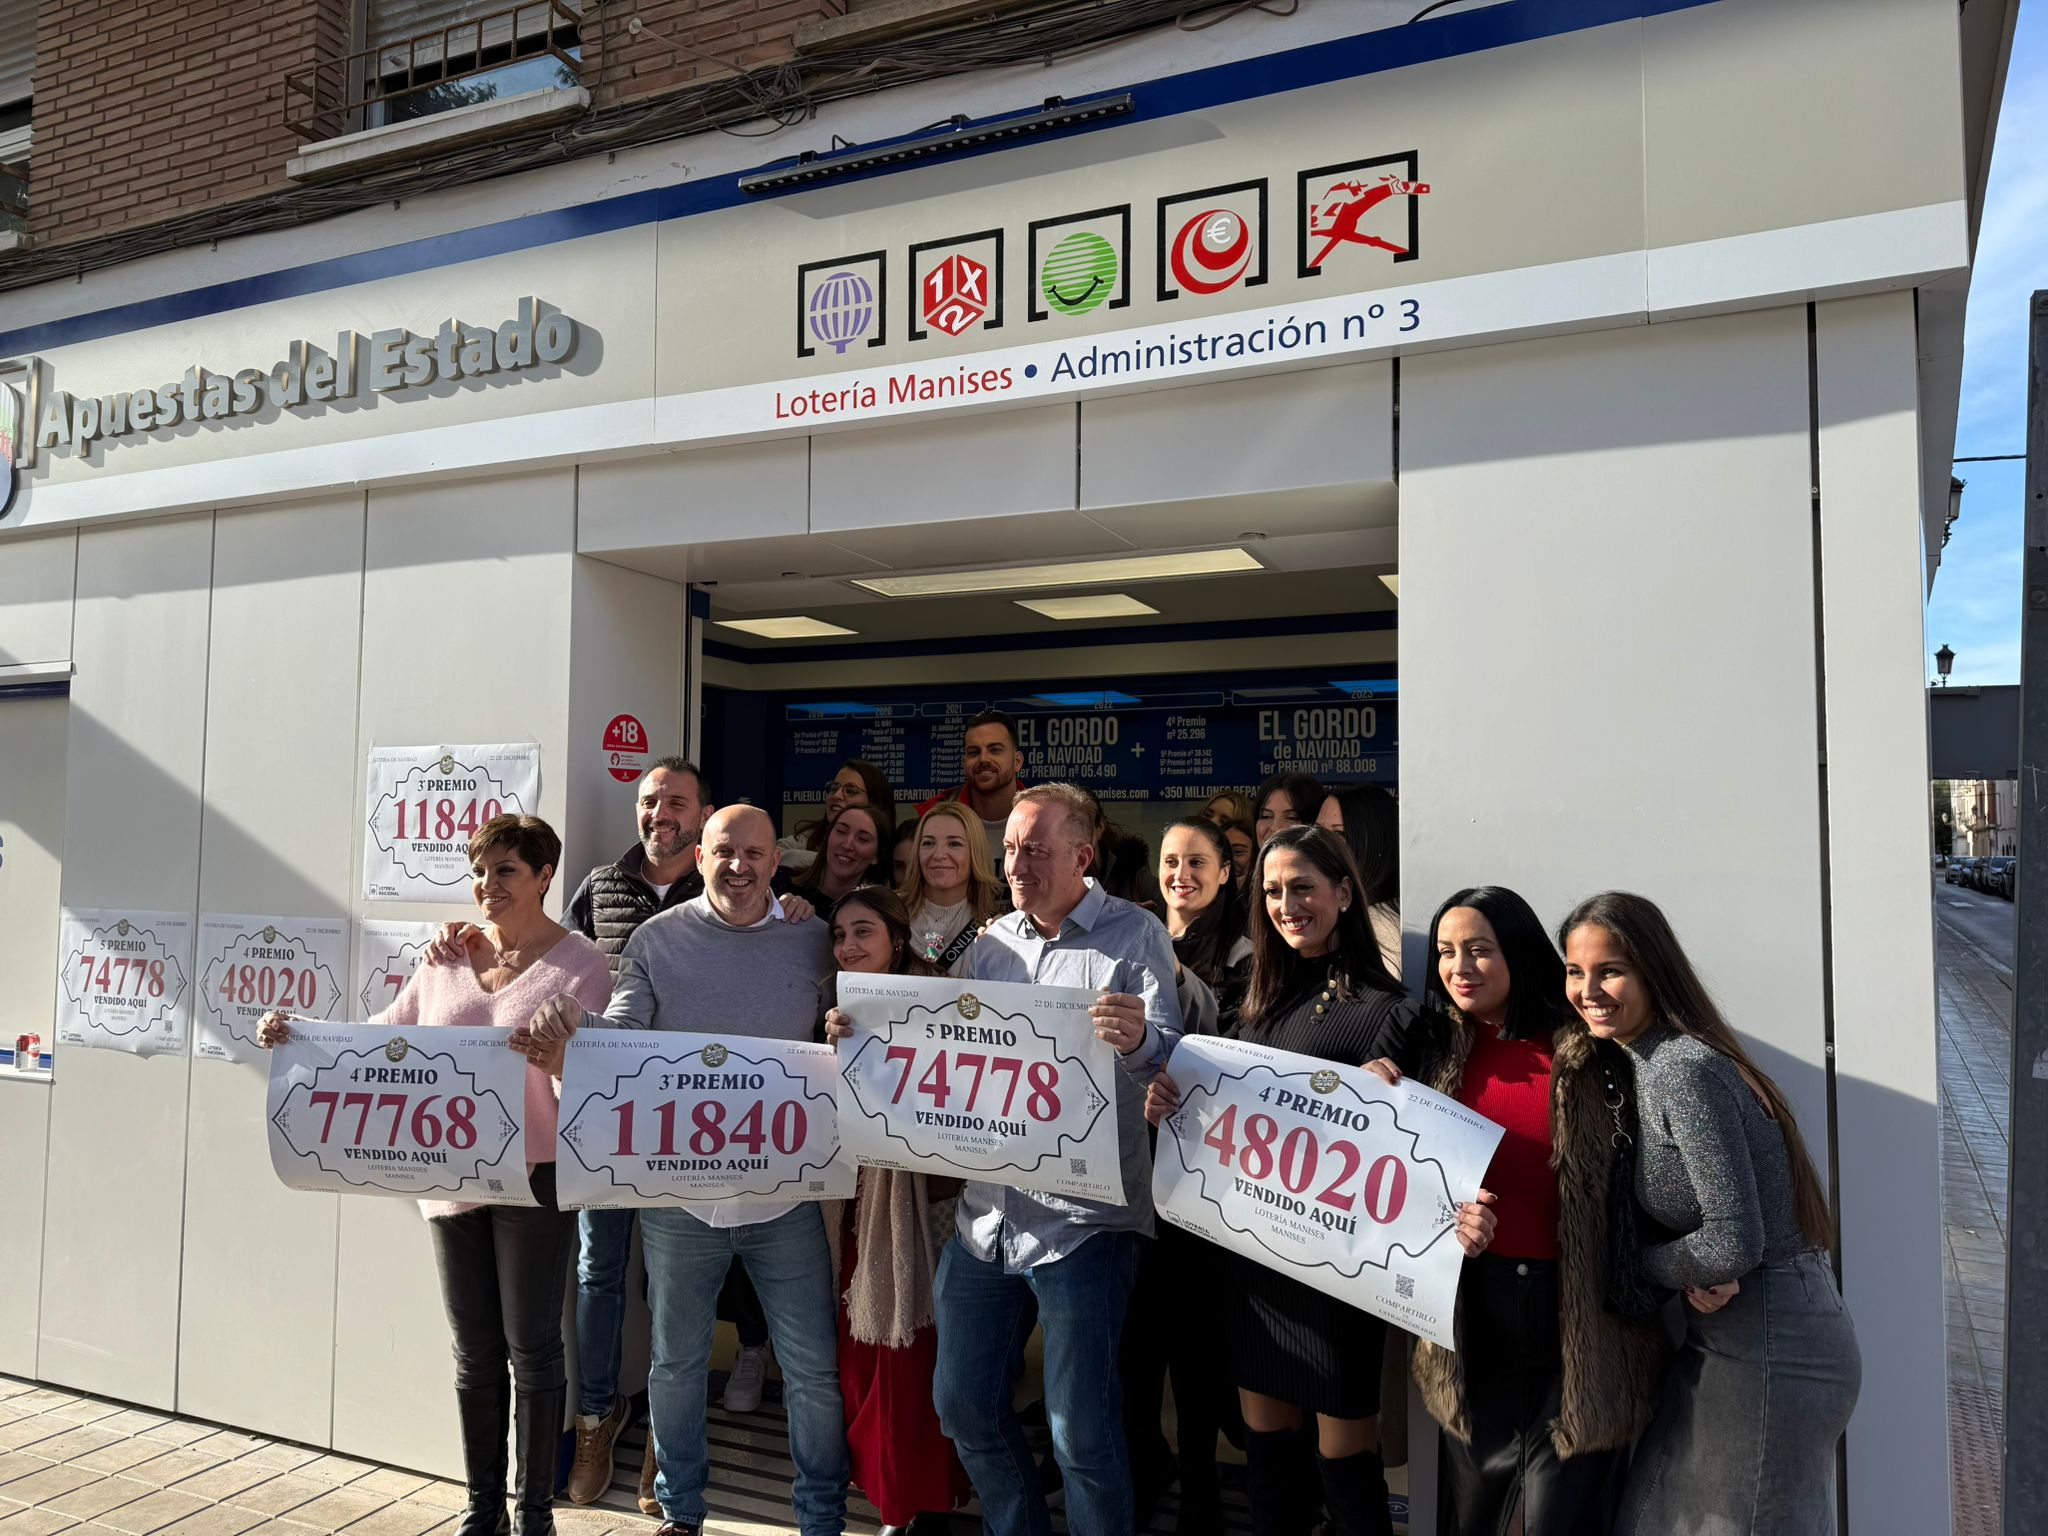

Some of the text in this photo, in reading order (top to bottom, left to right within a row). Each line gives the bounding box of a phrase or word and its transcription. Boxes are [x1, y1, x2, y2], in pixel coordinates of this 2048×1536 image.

[775, 298, 1421, 419] Lotería Manises Administración nº 3
[37, 295, 578, 459] Apuestas del Estado
[945, 704, 963, 714] 2021
[1177, 715, 1206, 727] Premio
[1258, 706, 1377, 741] EL GORDO
[612, 720, 639, 744] +18
[1017, 716, 1119, 748] EL GORDO
[1177, 728, 1206, 740] 25.296
[1028, 745, 1103, 766] de NAVIDAD
[1273, 738, 1361, 761] de NAVIDAD
[1031, 764, 1067, 780] PREMIO
[1081, 763, 1117, 779] 05.490
[1259, 761, 1276, 775] 1er
[1278, 758, 1319, 774] PREMIO
[1336, 759, 1377, 774] 88.008
[428, 778, 477, 792] PREMIO
[1159, 785, 1182, 799] +350
[783, 792, 791, 803] EL
[792, 791, 821, 803] PUEBLO
[893, 788, 937, 801] REPARTIDO
[411, 842, 470, 854] VENDIDO AQ
[108, 940, 146, 953] PREMIO
[252, 946, 295, 961] PREMIO
[80, 955, 165, 998] 74778
[219, 963, 316, 1009] 48020
[875, 989, 884, 997] DE
[885, 988, 919, 999] NAVIDAD
[94, 995, 147, 1008] VENDIDO AQUÍ
[1034, 1000, 1091, 1011] 22 DE DICIEMB
[288, 1033, 311, 1042] OTERÍA
[322, 1035, 354, 1044] NAVIDAD
[939, 1023, 1017, 1047] PREMIO
[571, 1039, 660, 1050] LOTERÍA DE NAVIDAD
[787, 1047, 795, 1055] 22
[1237, 1046, 1274, 1062] NAVIDAD
[364, 1067, 439, 1085] PREMIO
[676, 1073, 765, 1091] PREMIO
[884, 1045, 1061, 1122] 74778
[1275, 1089, 1371, 1133] PREMIO
[1407, 1093, 1486, 1133] 22 DE DICIEMBRE
[309, 1090, 478, 1151] 77768
[609, 1099, 808, 1157] 11840
[915, 1110, 1027, 1137] VENDIDO AQUÍ
[937, 1131, 1003, 1148] LOTERÍA MANISES
[344, 1147, 448, 1165] VENDIDO AQUÍ
[954, 1144, 987, 1156] MANISES
[397, 1165, 428, 1174] MANISES
[646, 1155, 769, 1172] VENDIDO AQUÍ
[1204, 1104, 1408, 1226] 48020
[384, 1172, 415, 1181] MANISES
[708, 1174, 743, 1182] MANISES
[689, 1182, 725, 1190] MANISES
[1234, 1177, 1358, 1236] VENDIDO AQUÍ
[1254, 1207, 1326, 1241] LOTERÍA MANISES
[1271, 1226, 1307, 1246] MANISES
[1375, 1294, 1437, 1326] COMPARTIRLO
